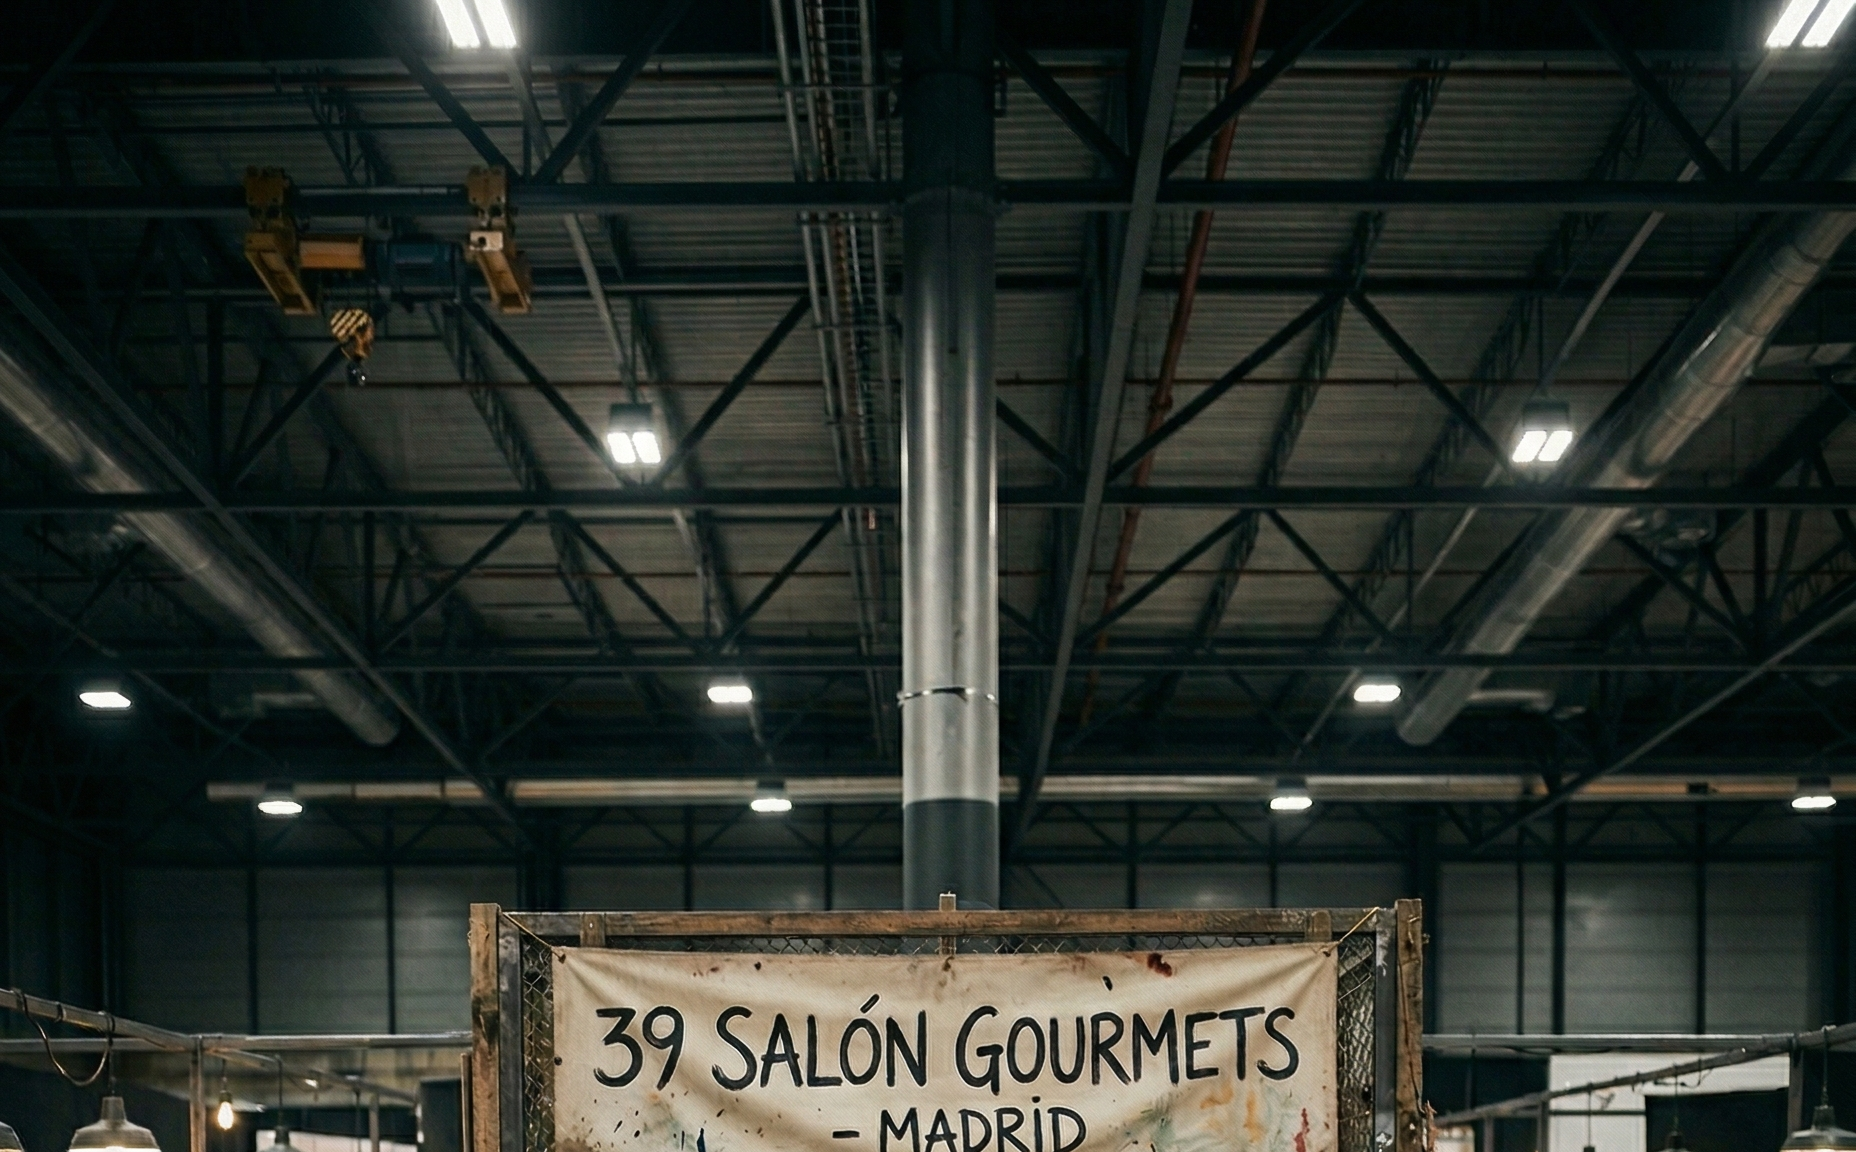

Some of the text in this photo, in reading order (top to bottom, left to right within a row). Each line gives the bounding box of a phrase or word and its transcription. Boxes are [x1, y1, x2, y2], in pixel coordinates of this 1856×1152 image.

[594, 993, 1300, 1096] 39 SALÓN GOURMETS
